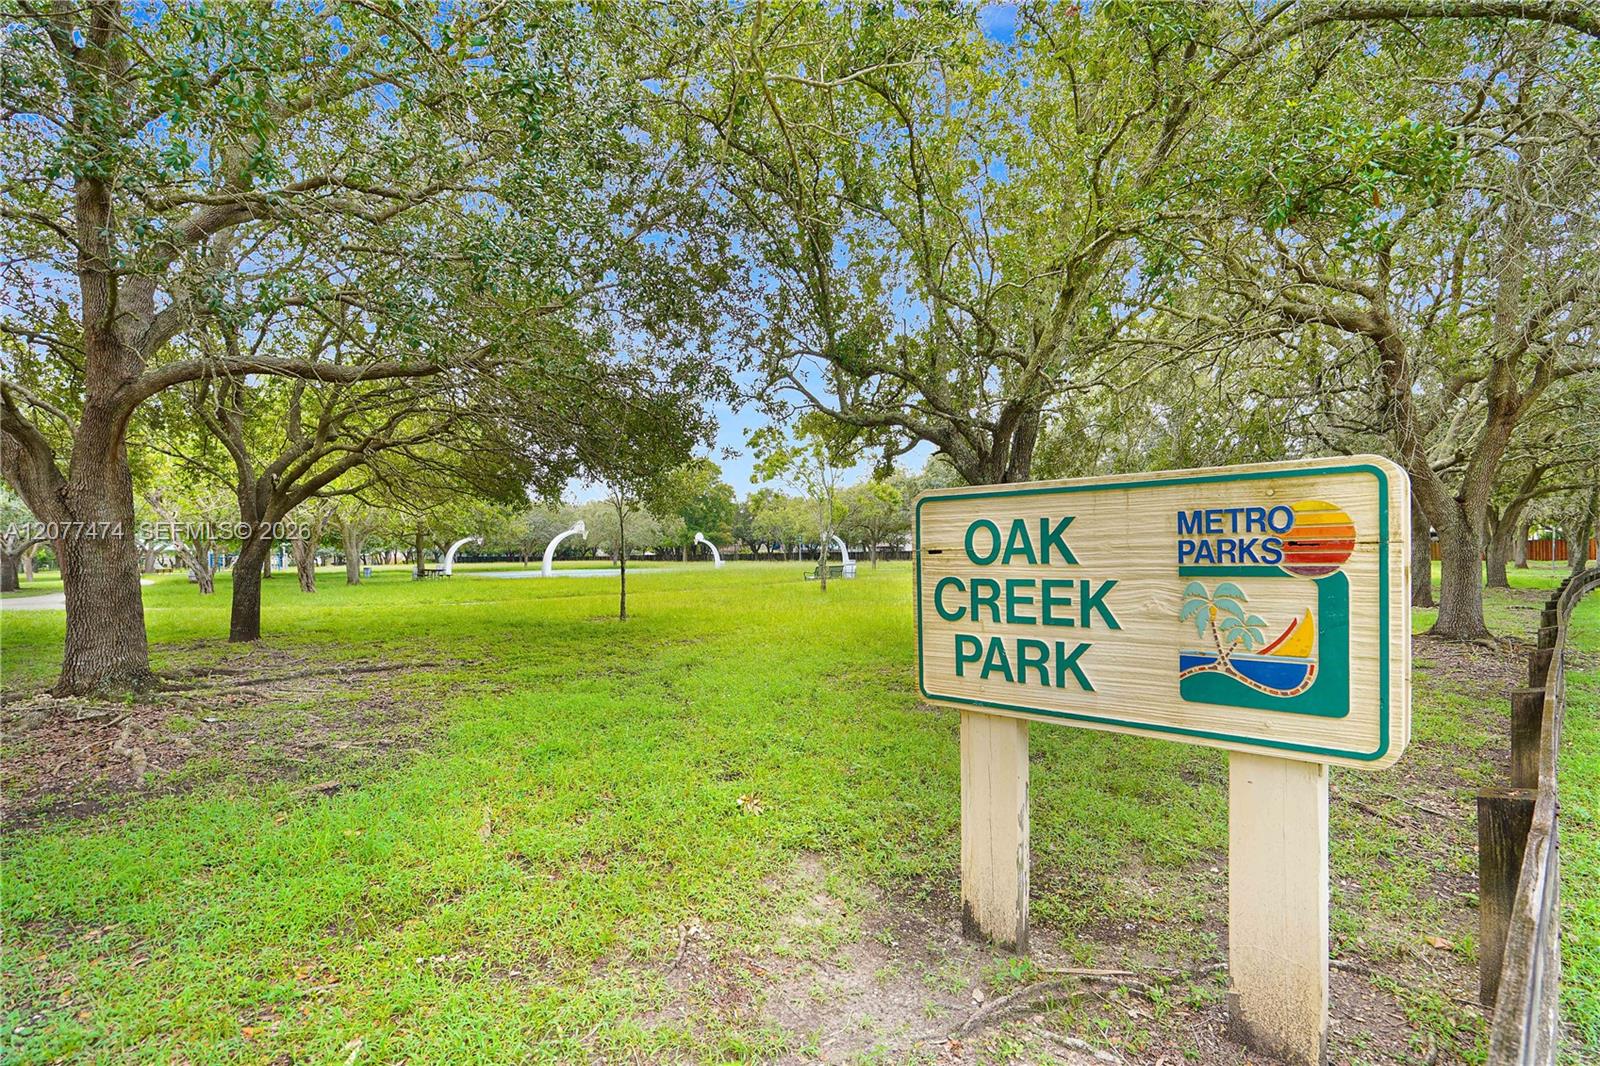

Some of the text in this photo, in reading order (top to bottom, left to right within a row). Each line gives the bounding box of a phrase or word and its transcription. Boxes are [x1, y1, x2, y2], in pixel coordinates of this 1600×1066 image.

[964, 516, 1080, 567] OAK
[1177, 504, 1295, 537] METRO
[1177, 537, 1284, 566] PARKS
[934, 576, 1123, 631] CREEK
[954, 634, 1097, 693] PARK
